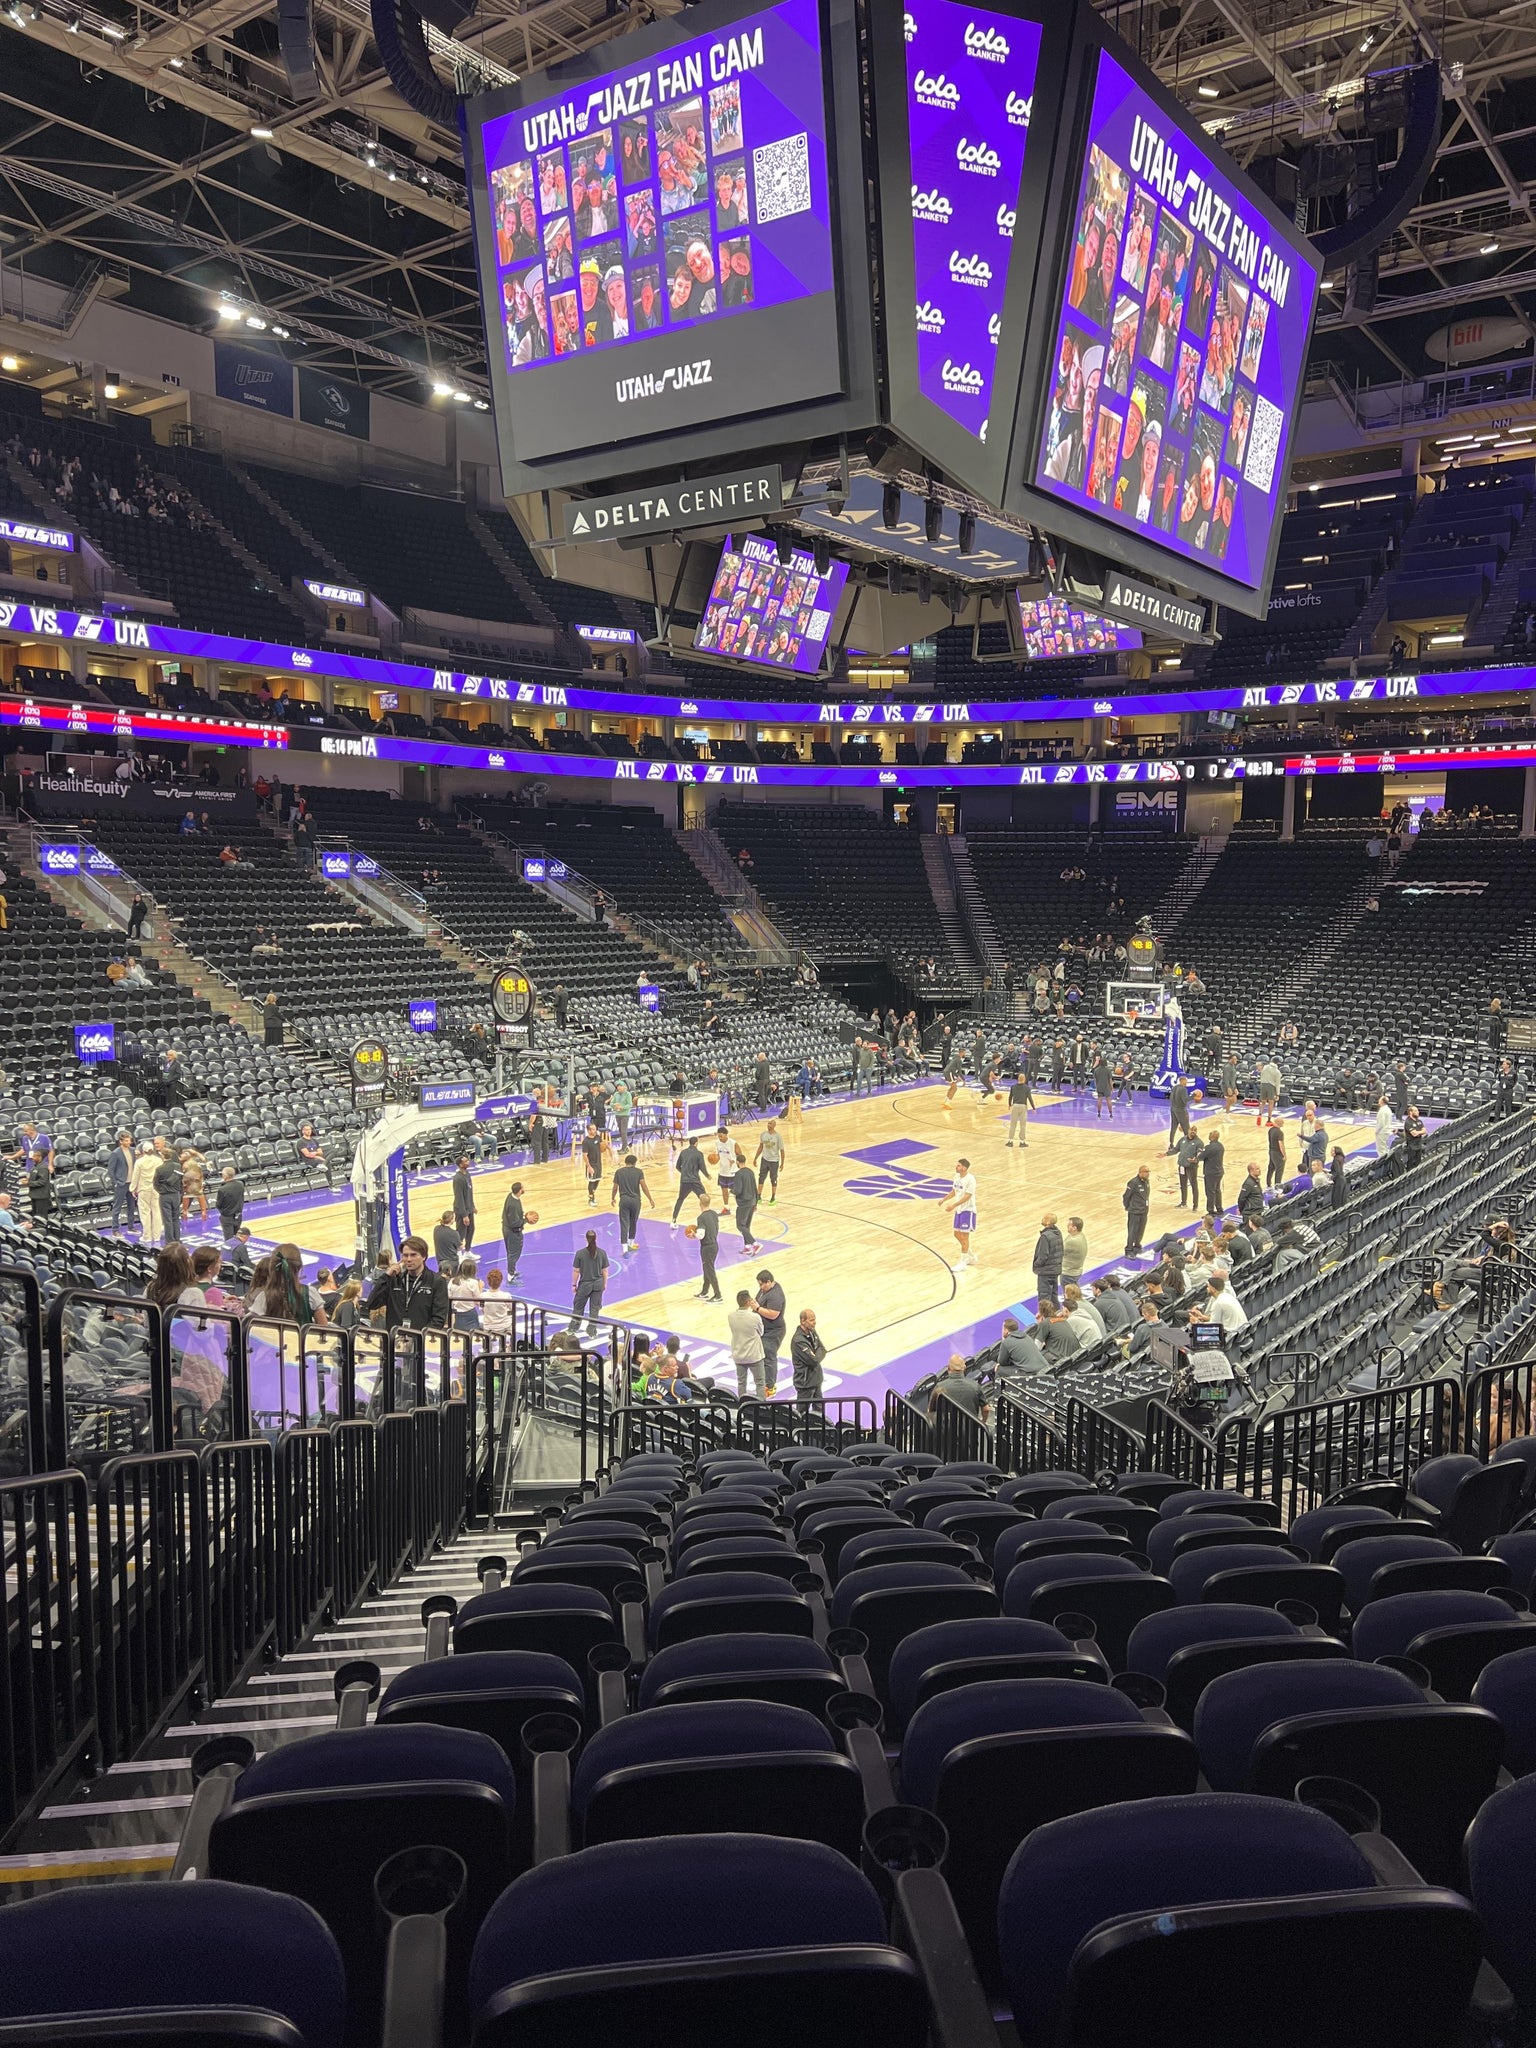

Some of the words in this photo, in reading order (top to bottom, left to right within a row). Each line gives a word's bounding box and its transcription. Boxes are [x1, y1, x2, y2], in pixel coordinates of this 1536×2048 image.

[964, 23, 1010, 55] lola
[966, 47, 1006, 64] BLANKETS
[523, 102, 575, 152] UTAH
[599, 71, 652, 125] JAZZ
[657, 51, 703, 102] FAN
[710, 27, 764, 81] CAM
[914, 70, 960, 103] lola
[916, 94, 957, 110] BLANKETS
[1006, 91, 1032, 118] lol
[956, 138, 1001, 168] lola
[959, 161, 997, 177] BLANKETS
[1130, 115, 1178, 199] UTAH
[1189, 180, 1231, 253] JAZZ
[1230, 216, 1260, 280] FAN
[1258, 245, 1291, 308] CAM
[949, 250, 992, 279] lola
[951, 273, 989, 288] BLANKETS
[915, 301, 945, 325] ola
[1454, 324, 1483, 346] bill
[234, 364, 273, 385] UTAH
[616, 373, 655, 402] UTAH
[672, 359, 712, 387] JAZZ
[941, 359, 984, 387] lola
[944, 381, 980, 395] BLANKETS
[595, 498, 670, 529] DELTA
[679, 479, 771, 514] CENTER
[0, 522, 13, 536] TL
[50, 532, 69, 547] UTA
[743, 540, 768, 561] UTAH
[795, 555, 815, 575] FAN
[348, 591, 361, 603] UTA
[1268, 597, 1295, 609] otive
[1297, 593, 1321, 607] lofts
[1123, 588, 1160, 618] DELTA
[1163, 603, 1201, 633] CENTER
[30, 607, 62, 635] VS.
[115, 621, 150, 647] UTA
[618, 631, 631, 641] UTA
[433, 671, 456, 692] ATL
[490, 679, 510, 699] VS.
[543, 686, 567, 706] UTA
[1243, 688, 1270, 706] ATL
[1315, 682, 1340, 701] VS.
[1386, 677, 1418, 696] UTA
[819, 704, 844, 721] ATL
[883, 706, 904, 721] VS.
[943, 705, 970, 721] UTA
[321, 737, 346, 754] 06:14
[347, 740, 361, 756] PM
[362, 736, 377, 757] TA
[615, 762, 639, 779] ATL
[675, 765, 697, 782] VS.
[733, 767, 758, 783] UTA
[1020, 767, 1046, 783] ATL
[1087, 765, 1108, 782] VS.
[1186, 765, 1195, 778] 0
[1209, 764, 1218, 777] 0
[40, 776, 129, 798] HealthEquity
[194, 790, 220, 798] AMERICA
[1116, 791, 1178, 809] SME
[505, 1025, 529, 1033] TISSOT
[364, 1083, 385, 1092] TISSOT
[395, 1168, 404, 1199] FIRST
[396, 1200, 407, 1243] MERICA
